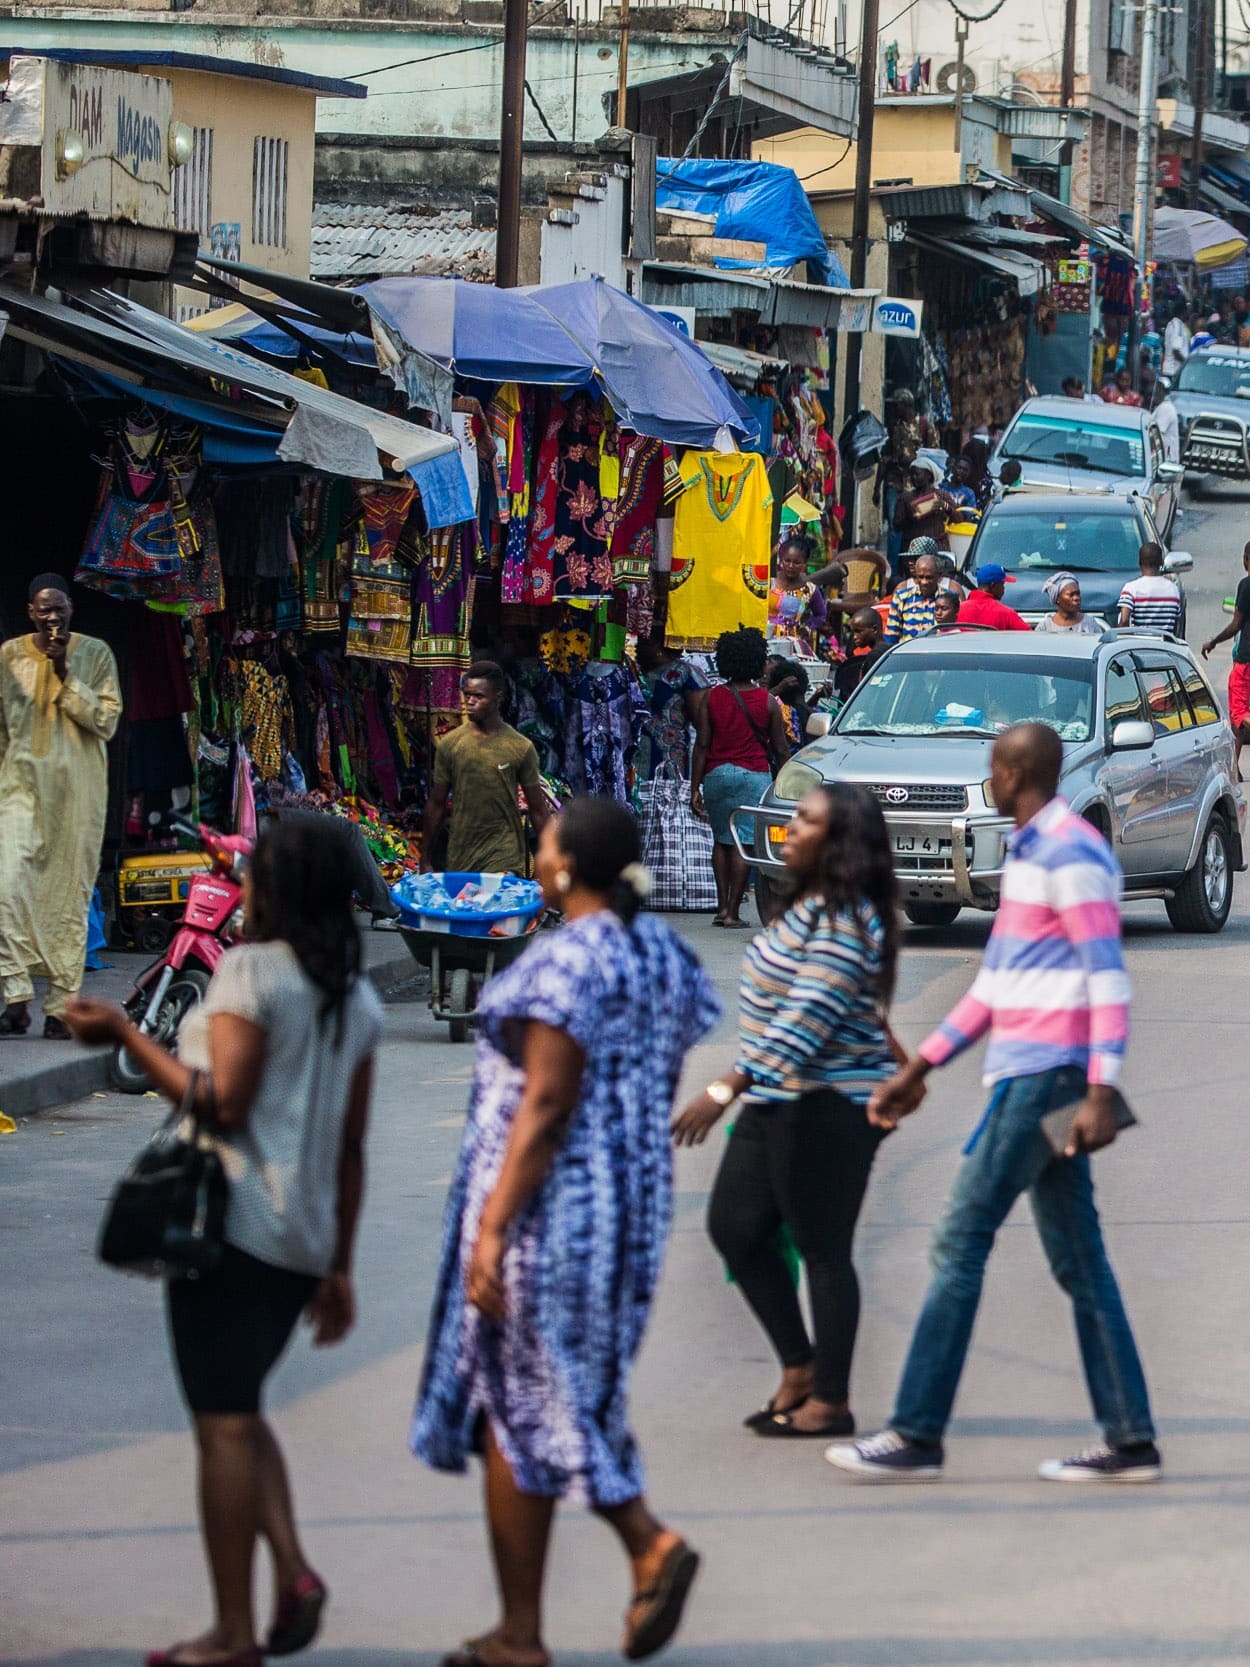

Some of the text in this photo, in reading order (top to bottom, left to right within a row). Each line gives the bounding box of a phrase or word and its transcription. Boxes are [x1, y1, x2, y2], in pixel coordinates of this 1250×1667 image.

[117, 95, 162, 176] Magasin
[880, 310, 912, 325] azur
[896, 836, 932, 852] LJ 4
